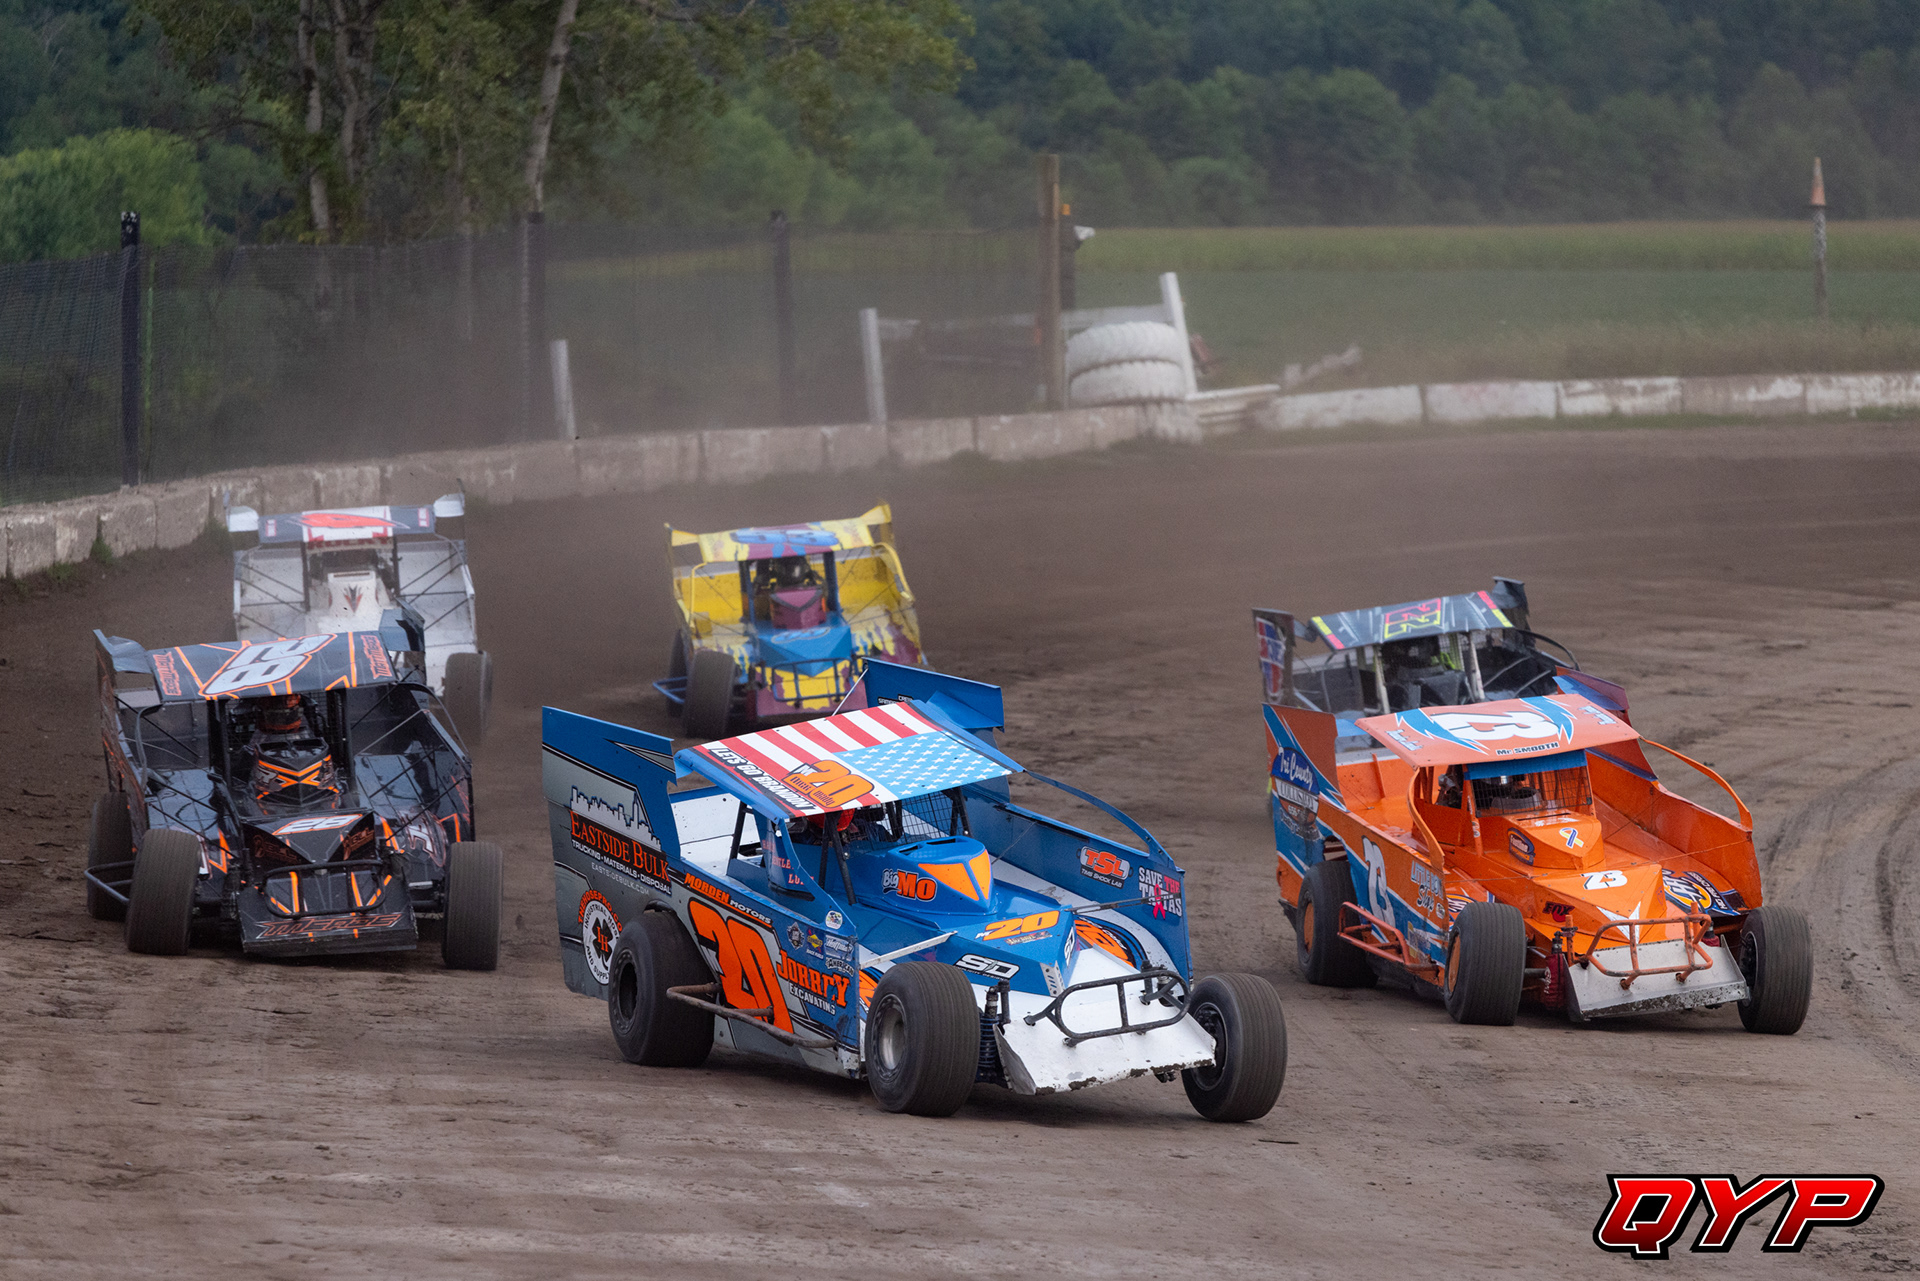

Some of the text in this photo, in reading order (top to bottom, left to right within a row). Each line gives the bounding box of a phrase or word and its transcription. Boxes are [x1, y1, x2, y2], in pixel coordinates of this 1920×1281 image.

[736, 762, 762, 777] GO
[752, 773, 815, 809] BRANDON
[570, 811, 670, 882] EASTSIDE BULK
[1086, 850, 1124, 876] TSL
[882, 868, 899, 888] Big
[1138, 866, 1181, 893] SAVE THE
[684, 873, 772, 924] MORDEN MOTORS
[1543, 901, 1574, 916] FOX
[955, 954, 1019, 979] SD
